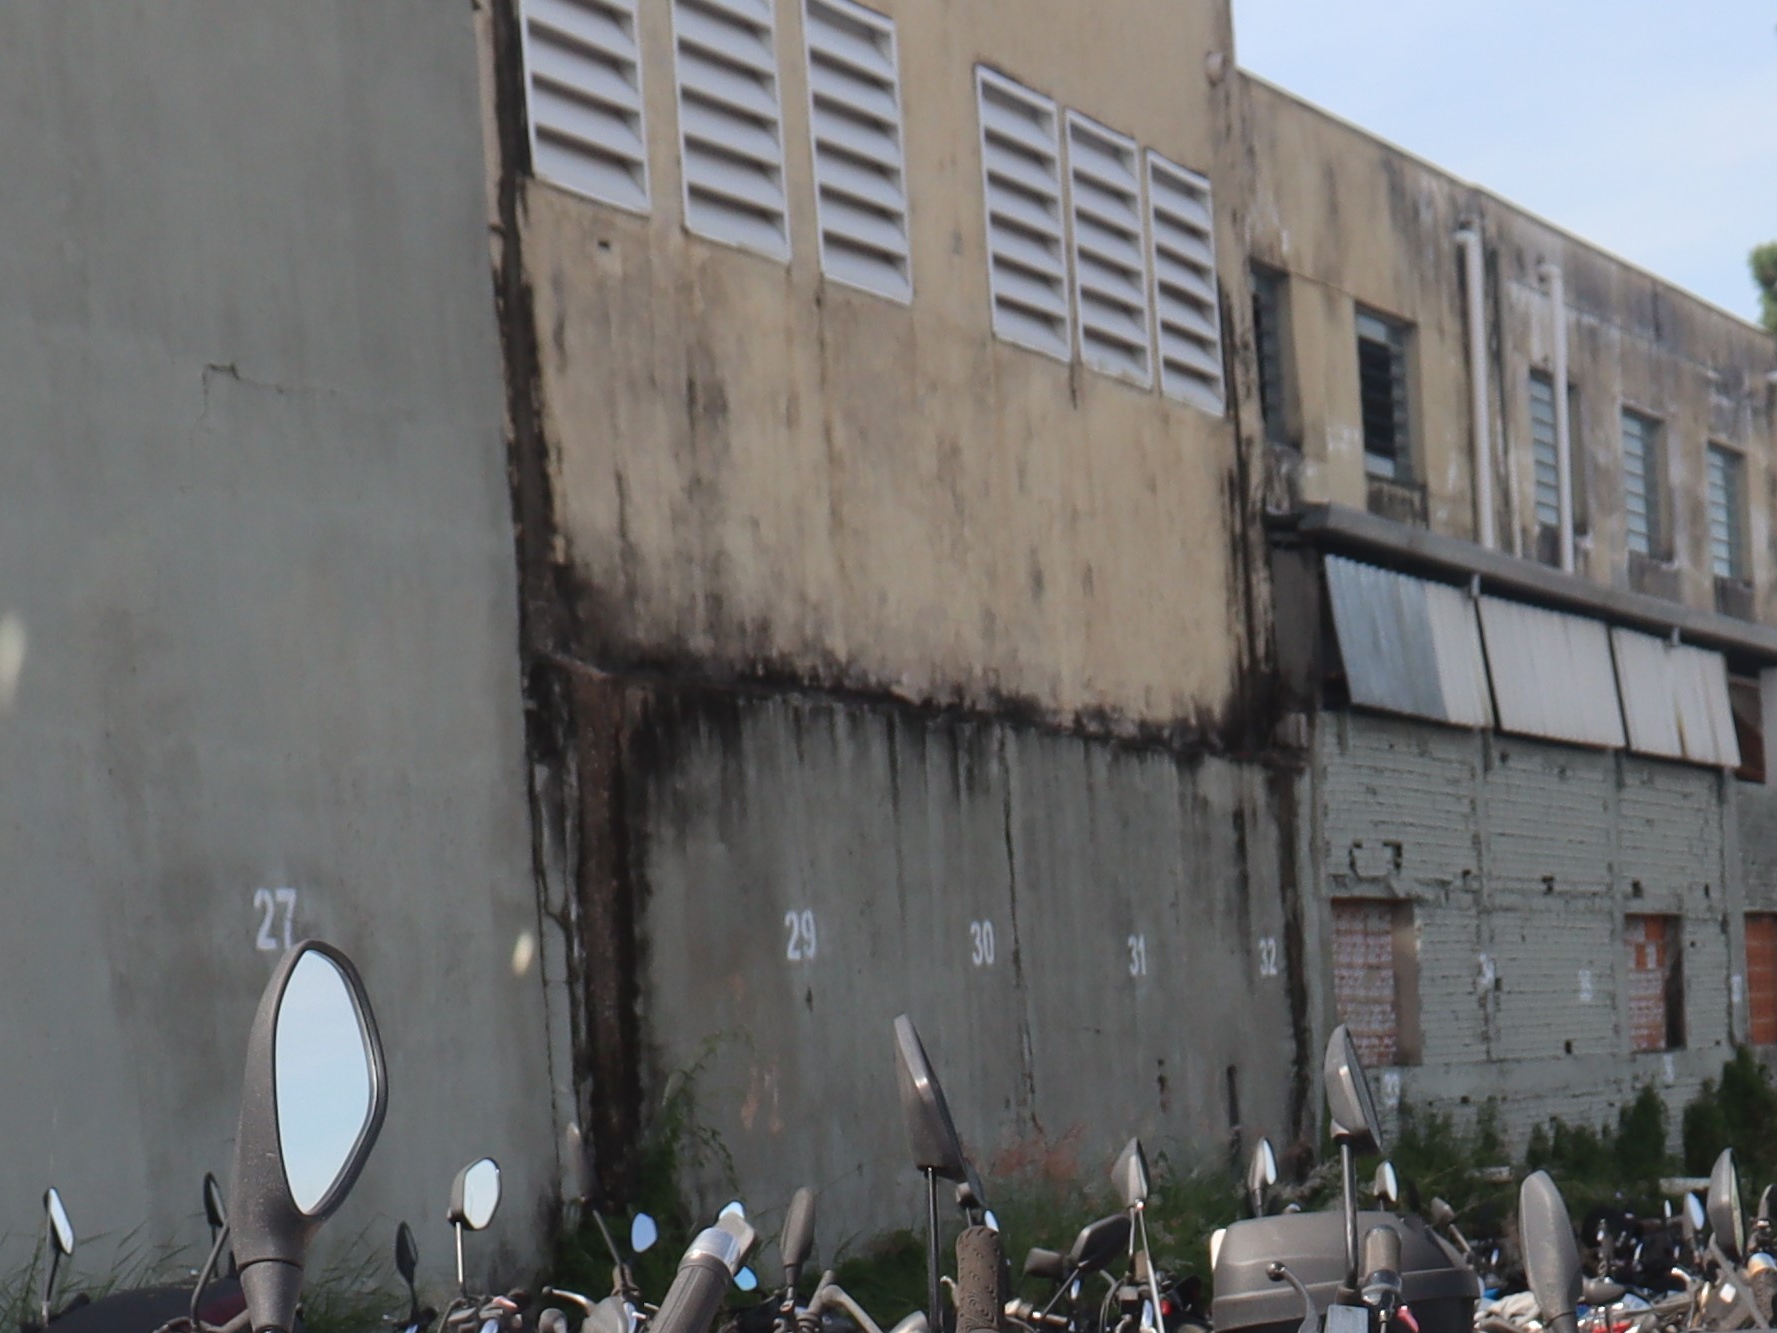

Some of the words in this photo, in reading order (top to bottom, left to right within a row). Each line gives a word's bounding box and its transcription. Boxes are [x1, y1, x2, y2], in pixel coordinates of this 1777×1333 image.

[253, 887, 297, 950] 27
[784, 909, 818, 961] 29
[969, 919, 995, 966] 30
[1128, 934, 1147, 977] 31
[1258, 937, 1277, 978] 32
